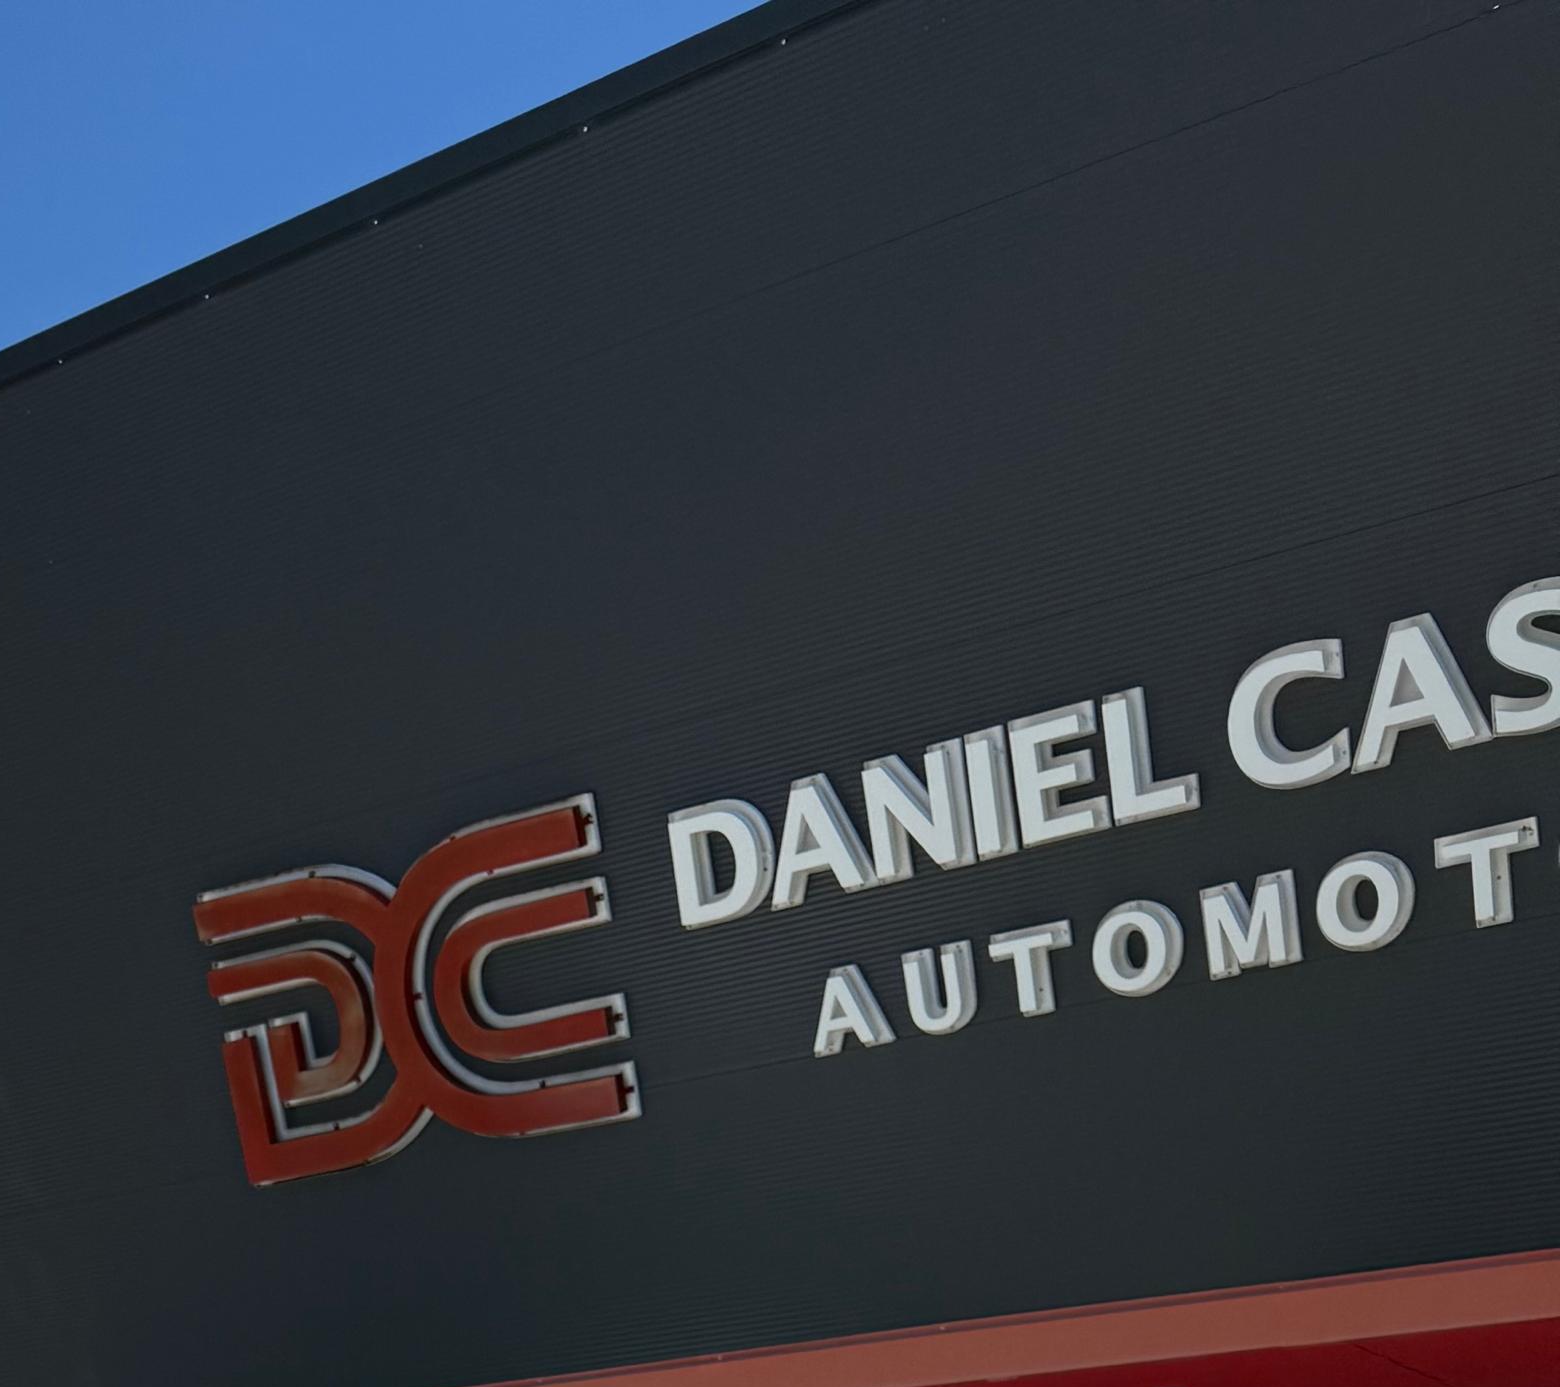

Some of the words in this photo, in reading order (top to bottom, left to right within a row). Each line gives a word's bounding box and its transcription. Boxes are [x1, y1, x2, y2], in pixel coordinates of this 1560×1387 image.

[667, 685, 1201, 929] DANIEL
[1227, 575, 1560, 790] CAS
[812, 816, 1540, 1058] AUTOMOT
